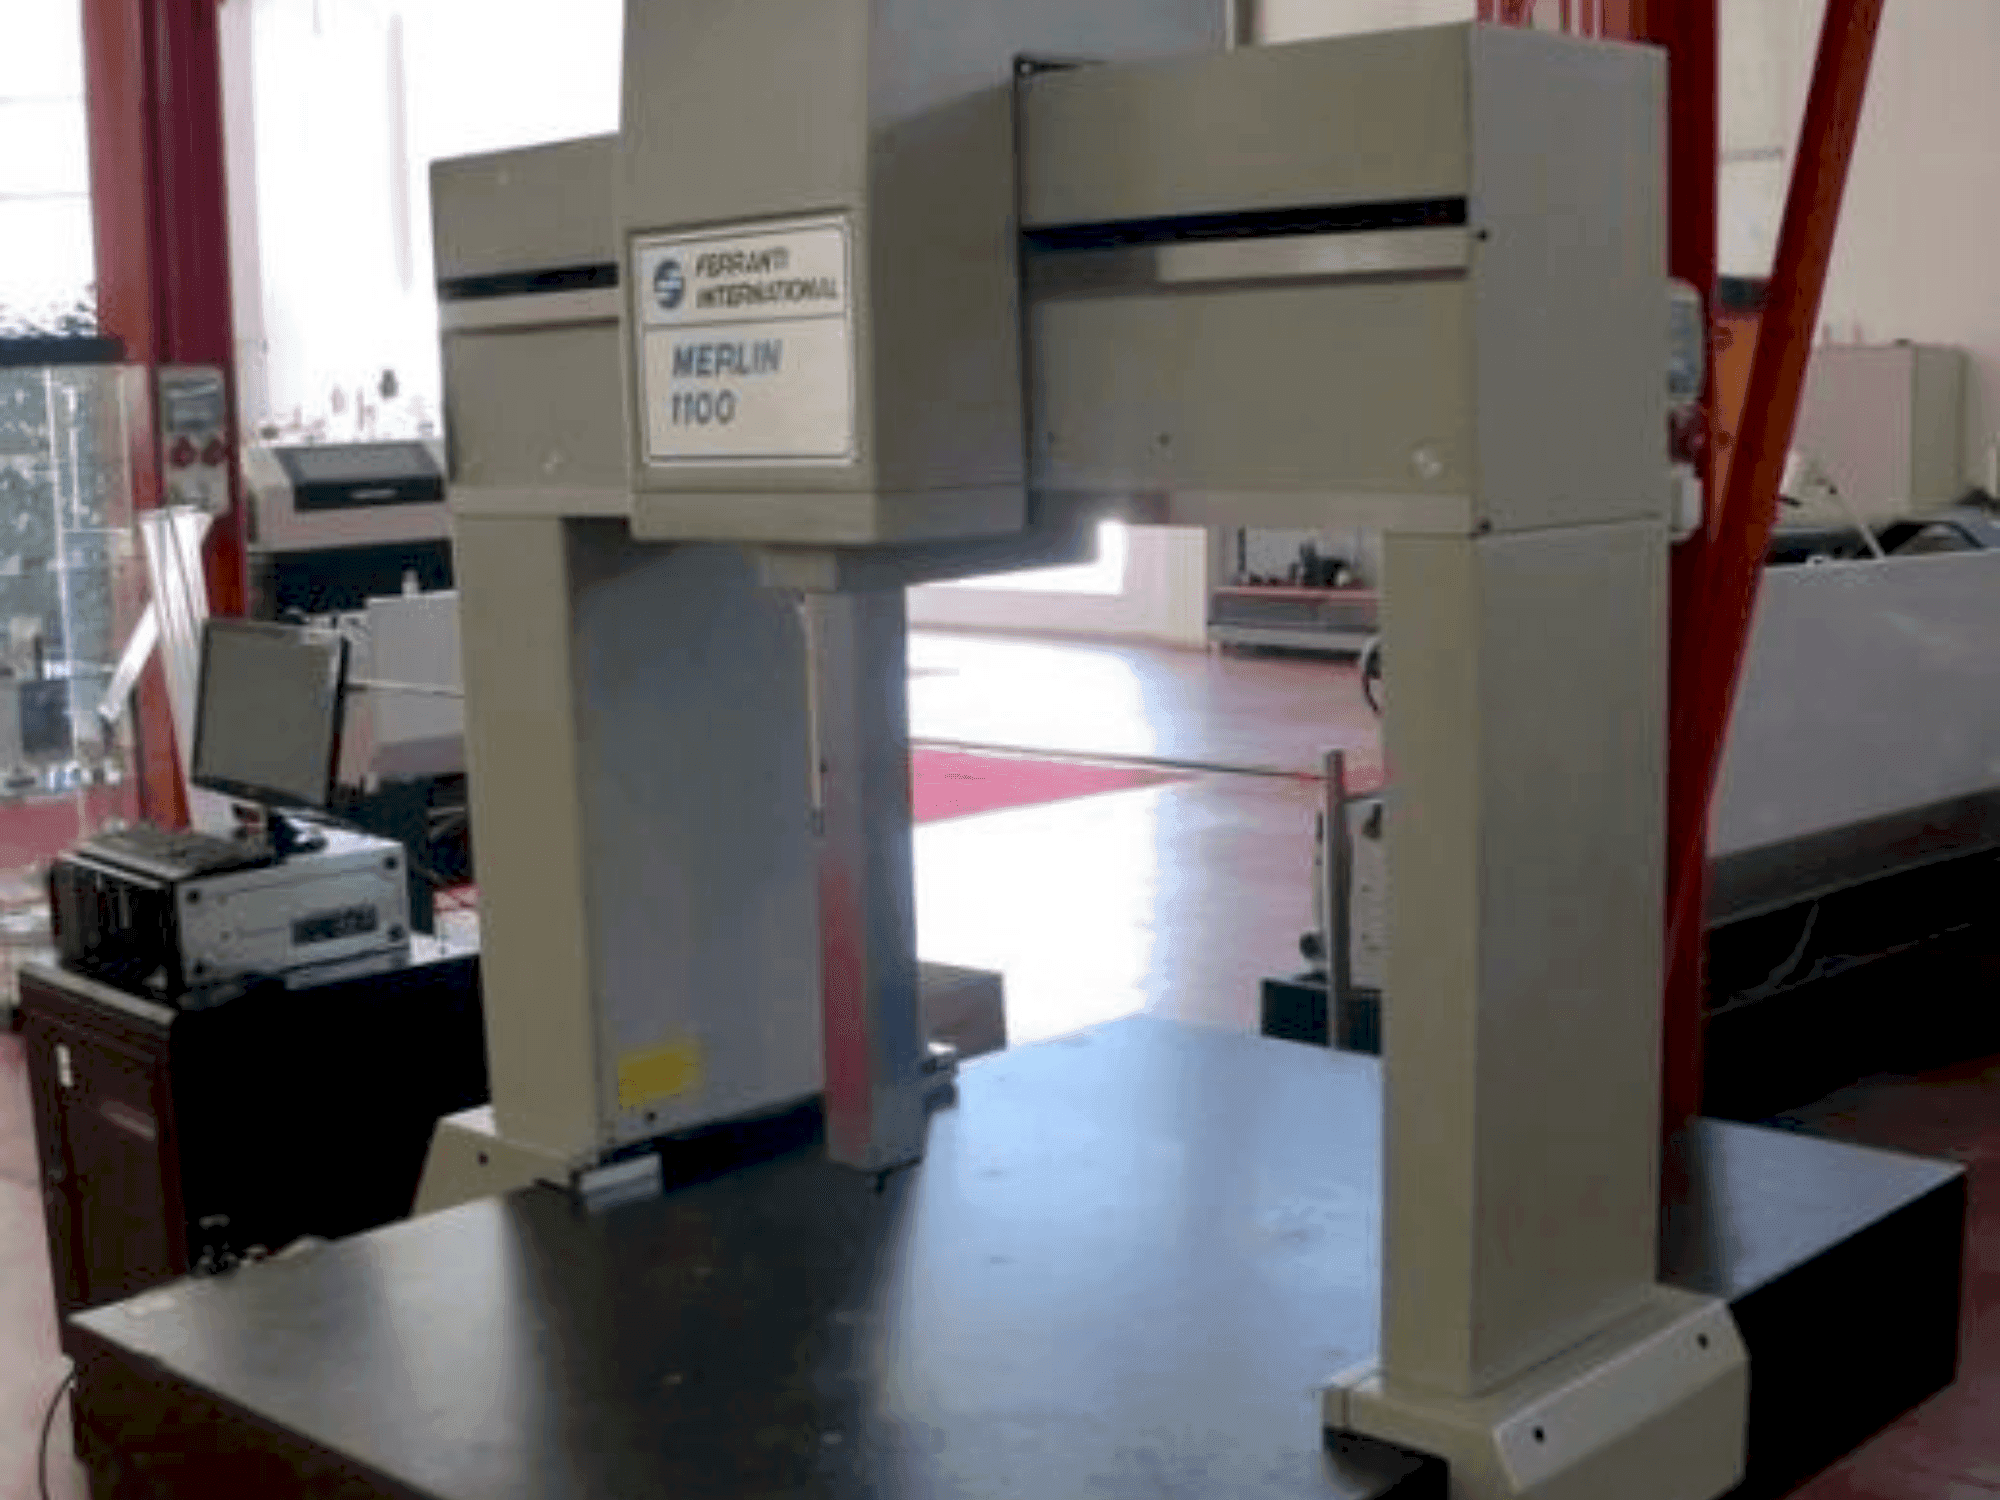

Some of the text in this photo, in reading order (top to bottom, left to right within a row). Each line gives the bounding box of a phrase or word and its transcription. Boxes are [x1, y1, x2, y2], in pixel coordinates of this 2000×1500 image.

[696, 277, 838, 308] INTERNATIONAL
[672, 339, 782, 377] MERLIN
[672, 389, 737, 426] 1100
